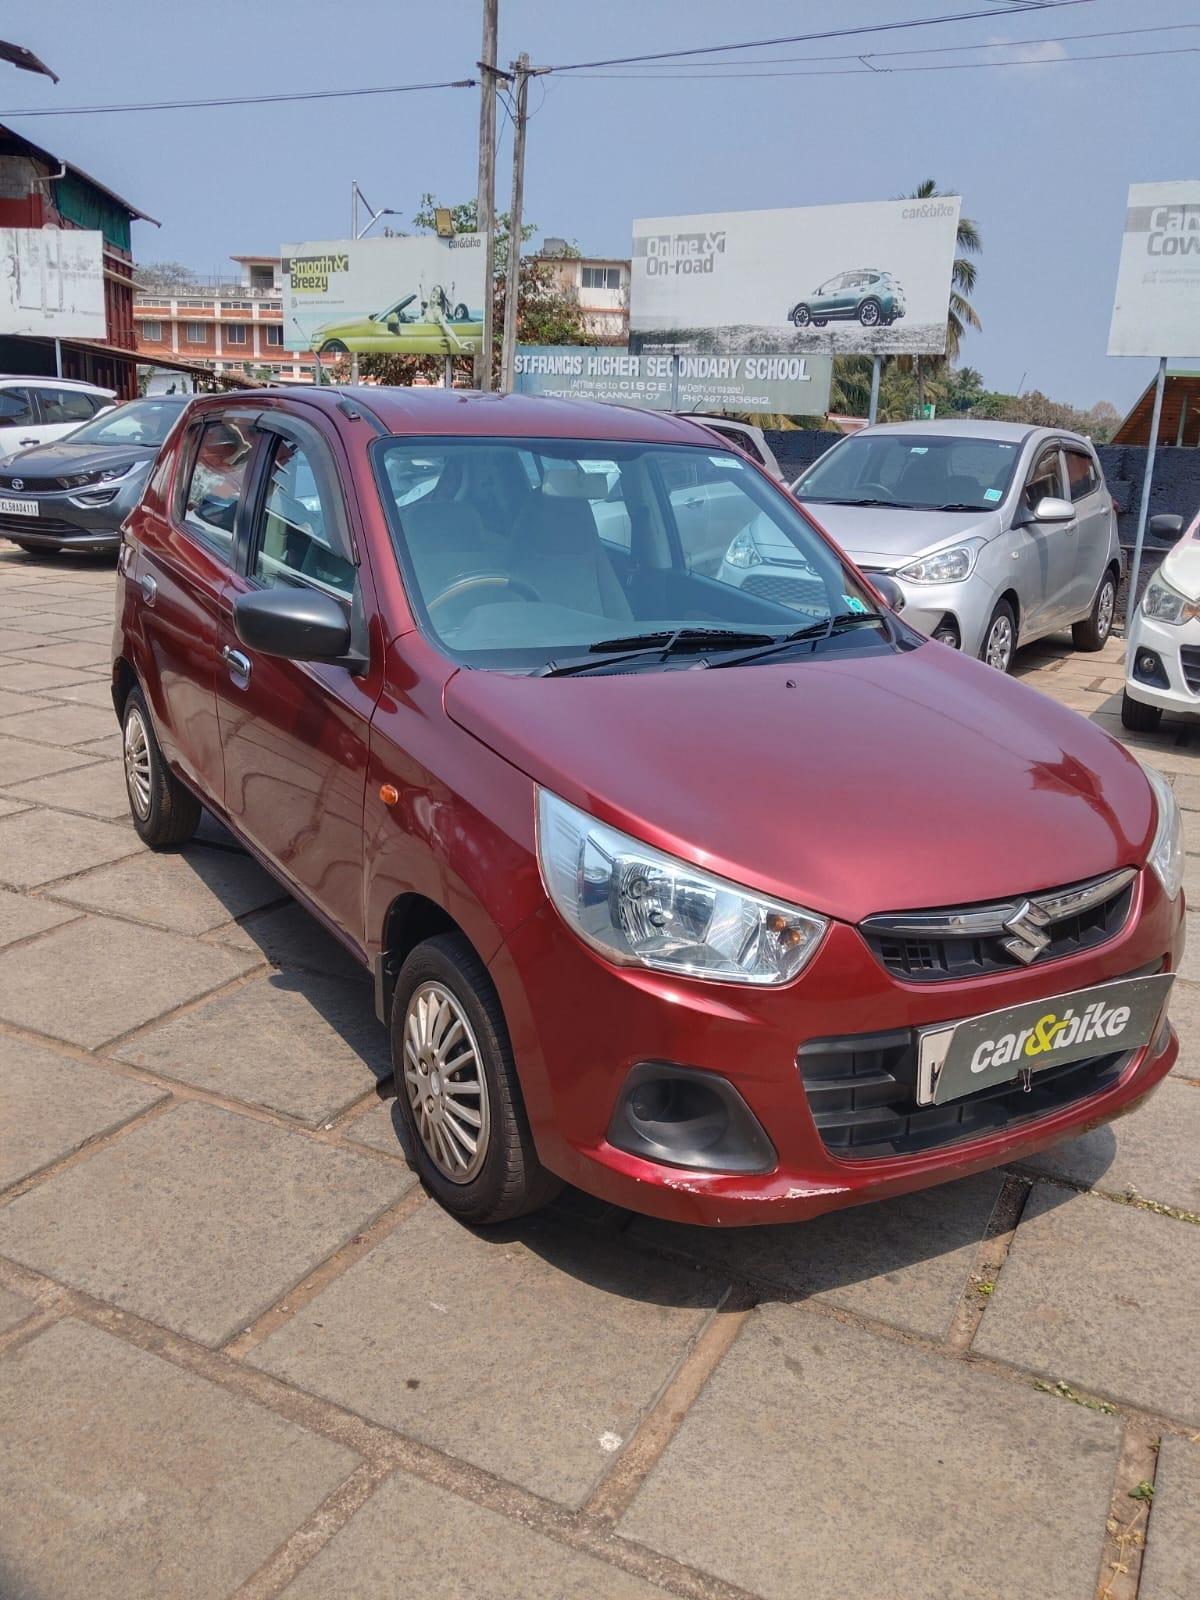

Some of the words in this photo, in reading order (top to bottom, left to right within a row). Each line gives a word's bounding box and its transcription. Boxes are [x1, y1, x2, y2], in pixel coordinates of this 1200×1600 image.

[902, 204, 954, 219] car&bike
[646, 234, 698, 257] Online
[289, 256, 332, 274] Smooth
[646, 254, 714, 276] On-road
[290, 273, 328, 292] Breezy
[514, 355, 583, 375] ST.FRANCIS
[588, 356, 640, 377] HIGHER
[647, 357, 741, 379] SECONDARY
[744, 358, 811, 381] SCHOOL
[970, 1001, 1131, 1074] car&bike
